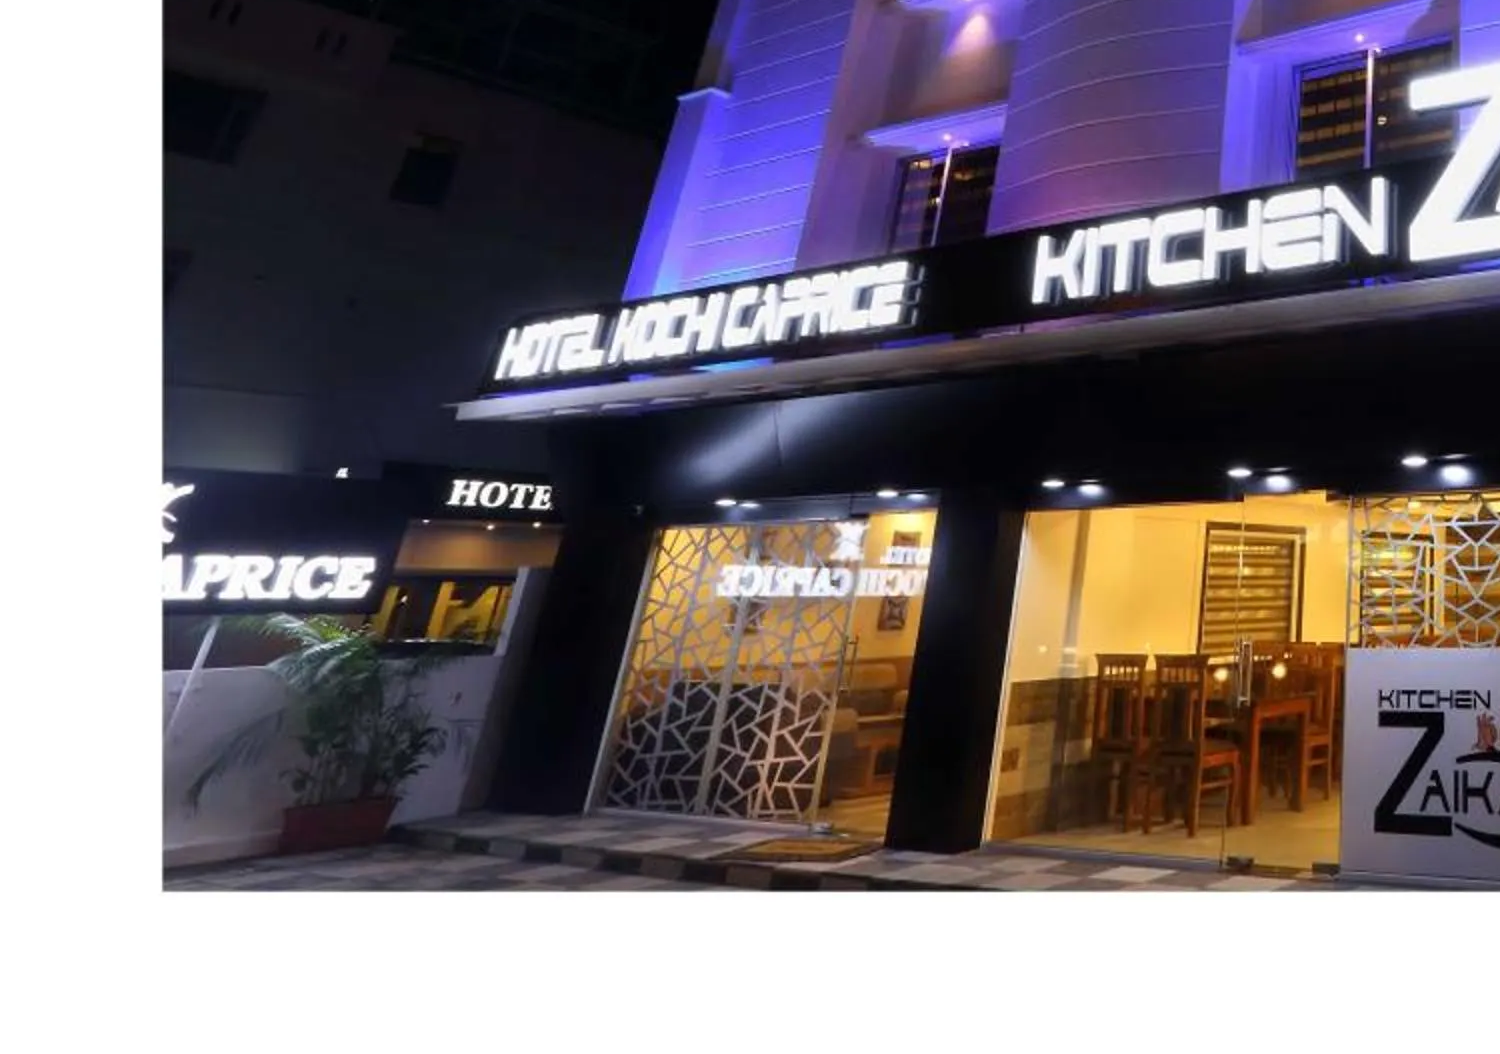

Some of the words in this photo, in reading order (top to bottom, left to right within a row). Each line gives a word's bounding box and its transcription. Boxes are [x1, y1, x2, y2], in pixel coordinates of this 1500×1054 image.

[1032, 177, 1390, 304] KITCHEN
[495, 314, 604, 380] HOTEL
[608, 292, 727, 364] KOCHI
[722, 261, 910, 348] CAPRICE
[1378, 689, 1491, 709] KITCHEN
